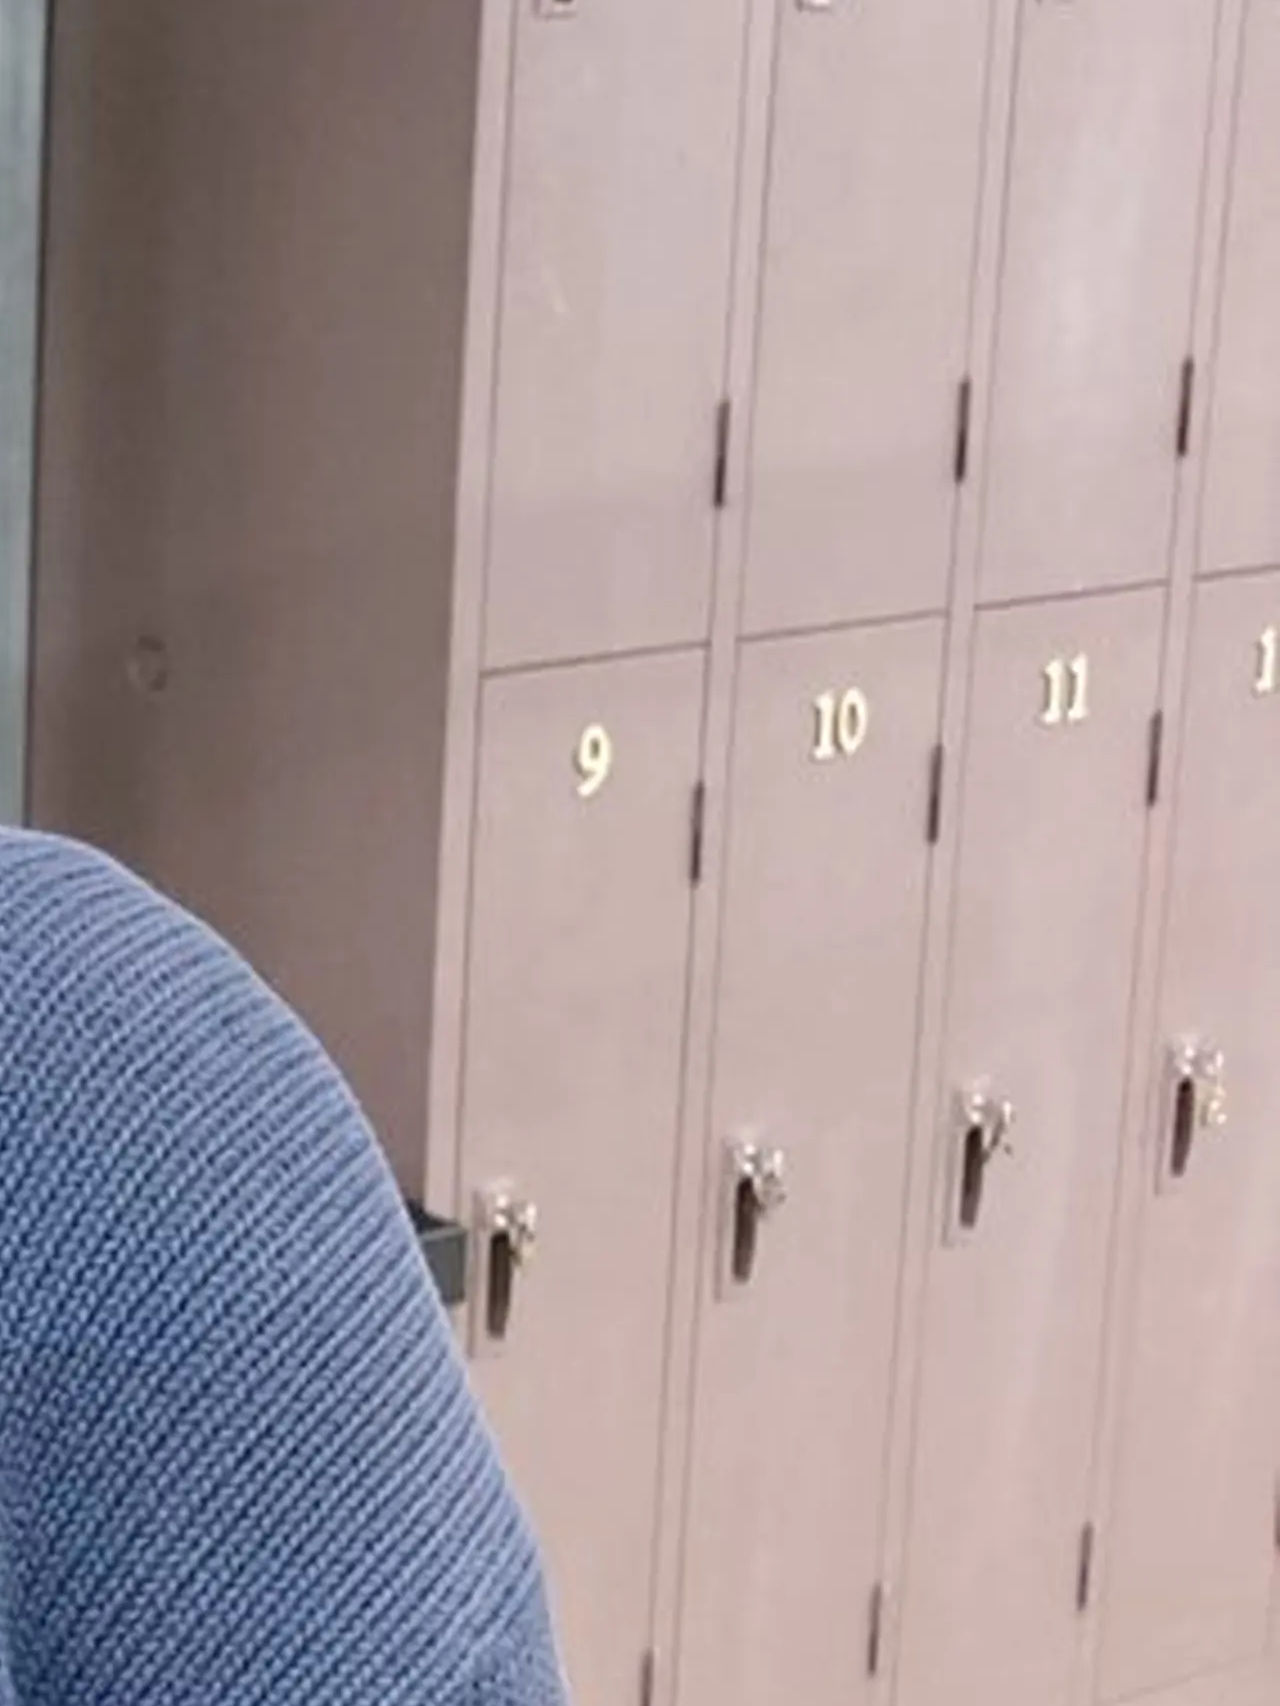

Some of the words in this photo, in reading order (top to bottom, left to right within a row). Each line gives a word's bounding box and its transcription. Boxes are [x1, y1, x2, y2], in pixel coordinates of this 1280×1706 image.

[812, 688, 867, 760] 10
[1042, 654, 1089, 725] 11
[576, 724, 612, 797] 9
